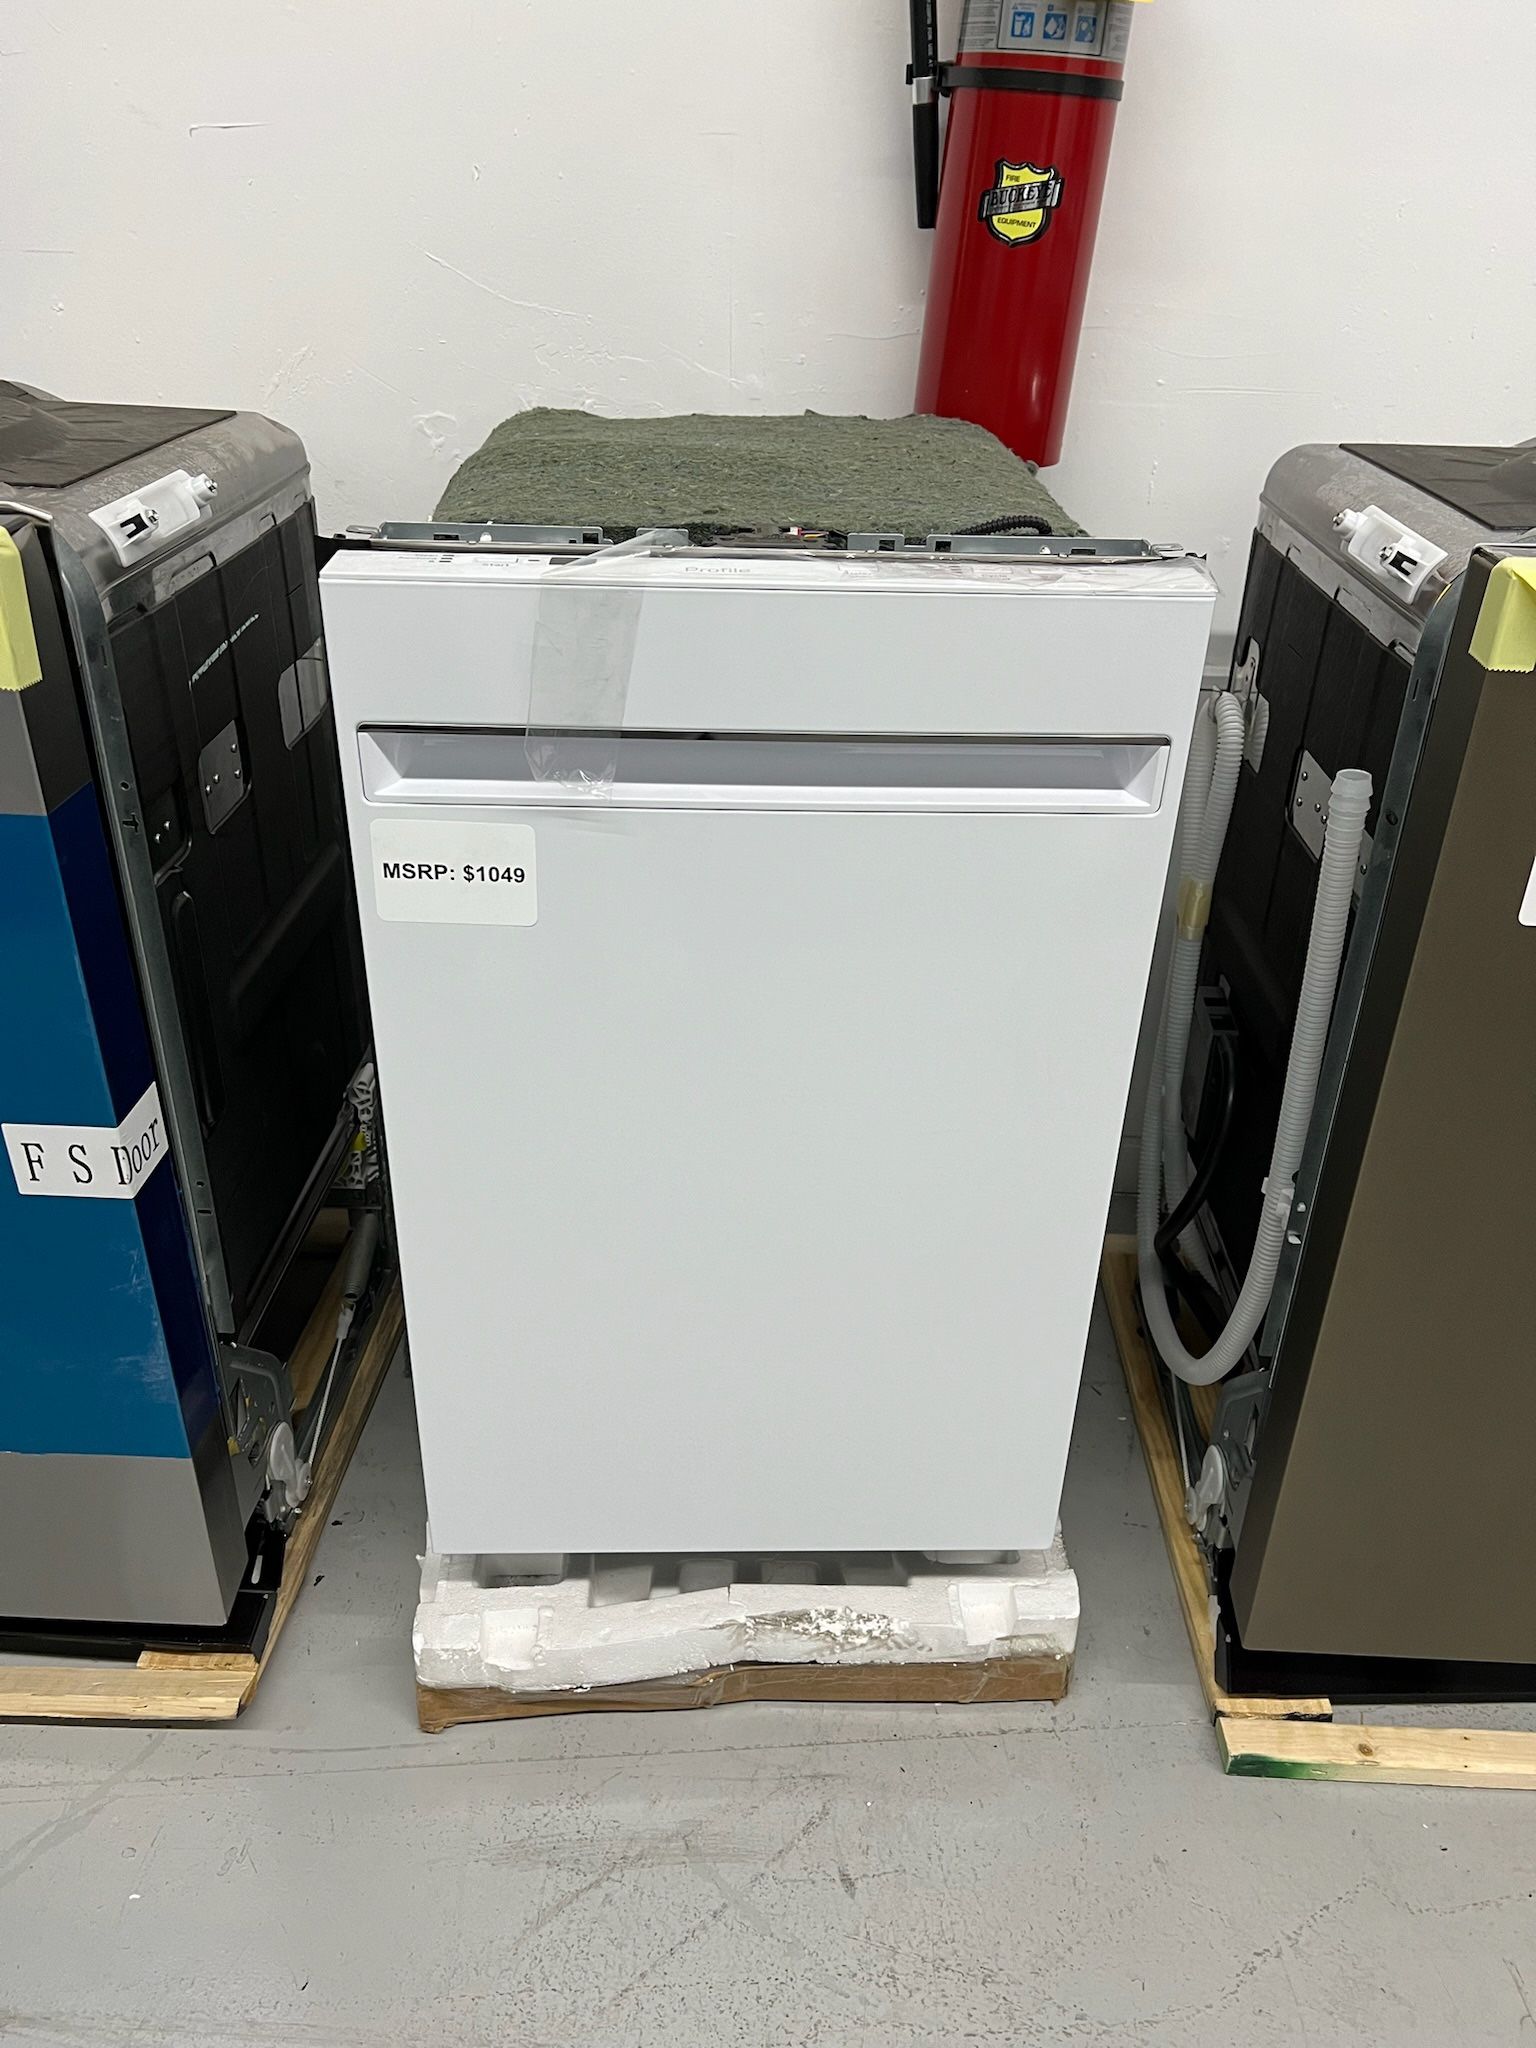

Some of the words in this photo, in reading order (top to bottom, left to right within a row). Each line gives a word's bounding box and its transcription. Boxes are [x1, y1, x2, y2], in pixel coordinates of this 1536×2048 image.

[1005, 174, 1021, 182] FIRE
[991, 180, 1053, 206] BUCKEYE
[997, 216, 1036, 228] EQUIPMENT
[685, 566, 751, 574] Profile
[382, 862, 455, 881] MSRP:
[463, 864, 526, 883] $1049
[20, 1142, 45, 1182] F
[68, 1144, 93, 1184] S
[110, 1117, 160, 1185] Door
